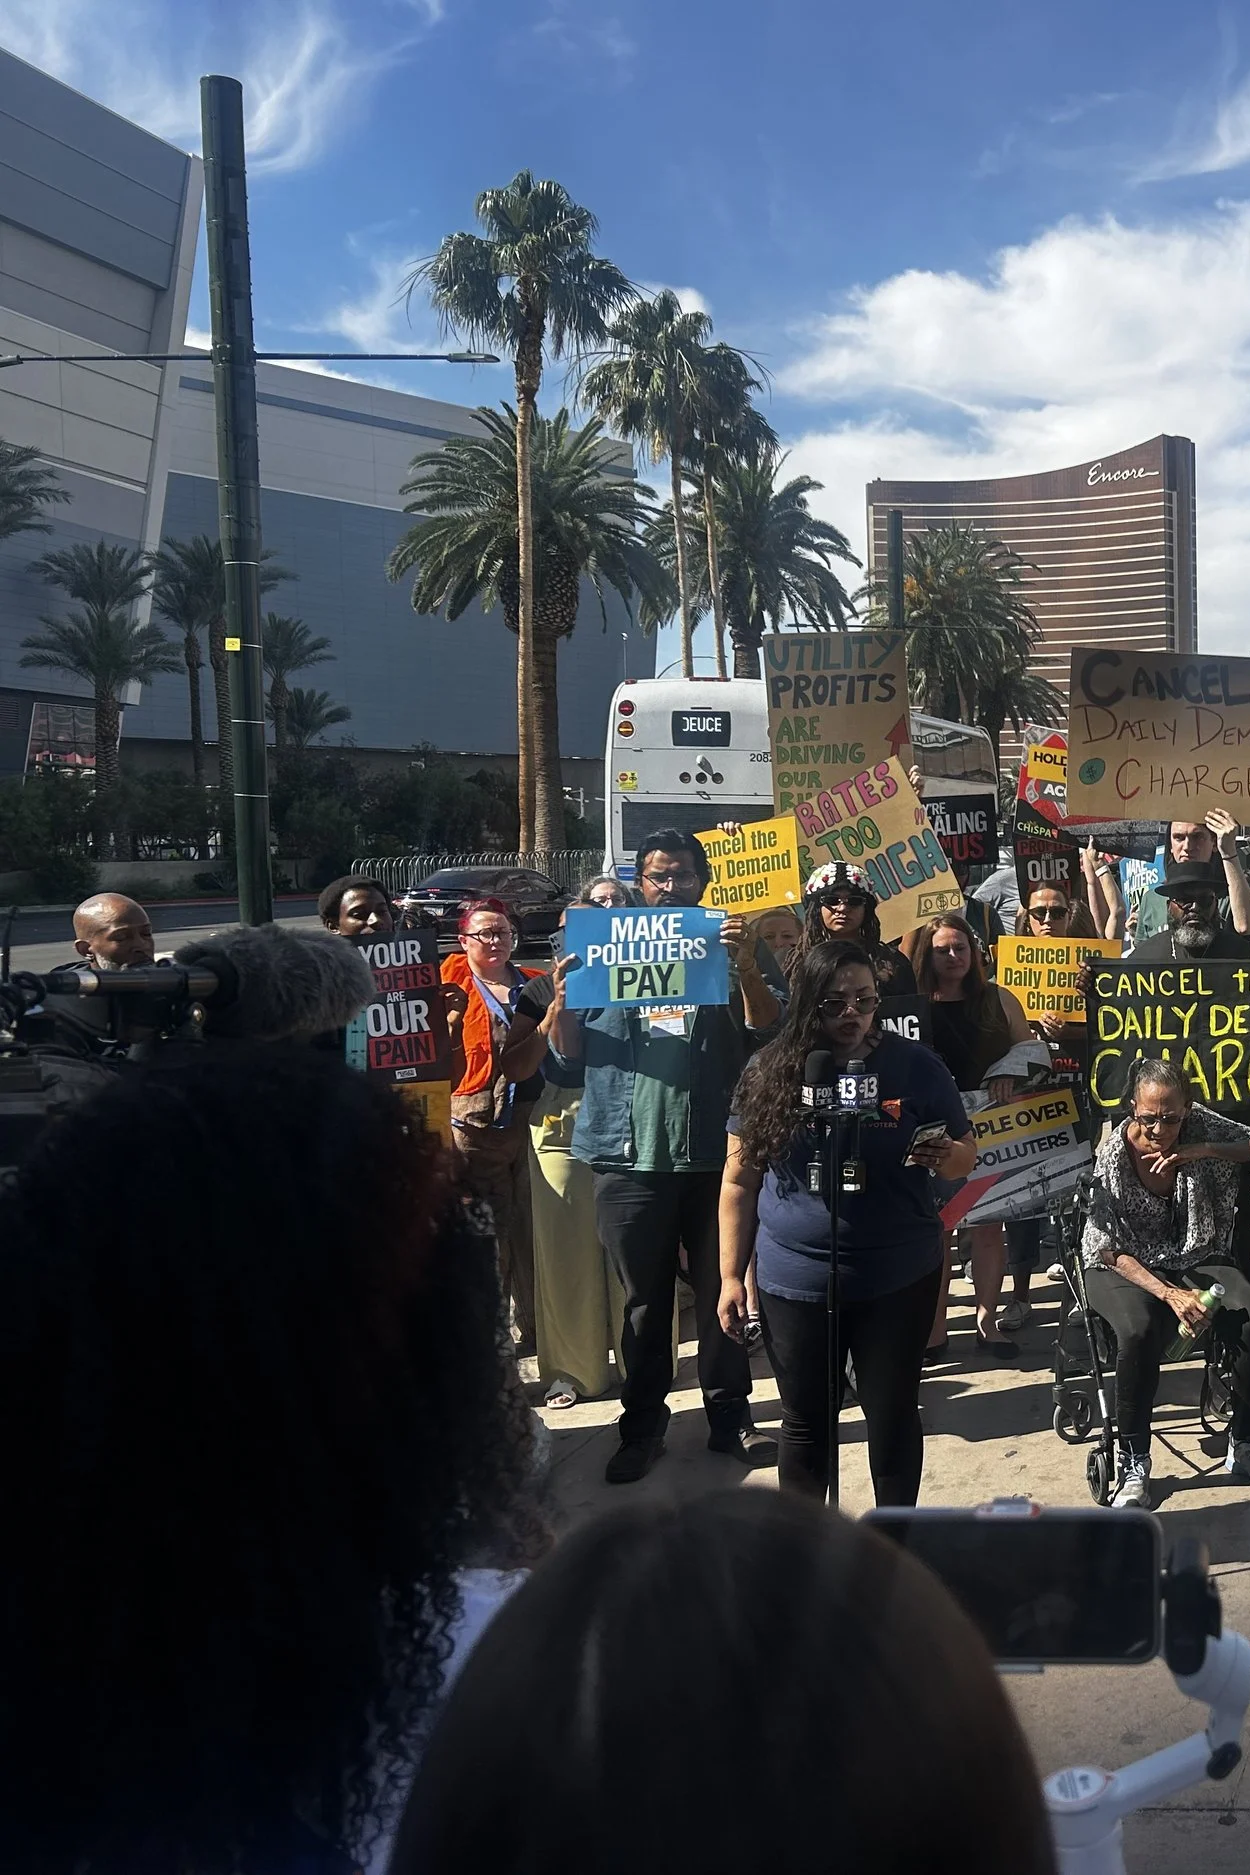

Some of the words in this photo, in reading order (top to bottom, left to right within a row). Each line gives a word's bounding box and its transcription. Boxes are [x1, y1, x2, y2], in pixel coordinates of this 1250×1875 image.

[1087, 463, 1159, 486] Encore
[767, 634, 900, 671] UTILITY
[770, 673, 897, 709] PROFITS
[682, 717, 722, 732] DEUCE
[775, 716, 821, 743] ARE
[1073, 704, 1177, 746] DAILY
[776, 743, 866, 765] DRIVING
[777, 771, 823, 788] OUR
[795, 761, 898, 838] RATES
[703, 833, 746, 859] ancel
[751, 830, 777, 851] the
[816, 816, 881, 861] TOO
[727, 849, 791, 880] Demand
[1027, 858, 1069, 882] OUR
[710, 878, 770, 906] Charge!
[611, 913, 683, 943] MAKE
[358, 940, 422, 968] YOUR
[587, 938, 707, 967] POLLUTERS
[1016, 944, 1070, 965] Cancel
[617, 963, 678, 998] PAY.
[1004, 967, 1042, 989] Daily
[1096, 968, 1213, 998] CANCEL
[386, 991, 406, 1003] ARE
[1027, 991, 1086, 1013] Charge
[366, 999, 431, 1038] OUR
[1097, 1002, 1199, 1040] DAILY
[374, 1033, 433, 1067] PAIN
[816, 1086, 834, 1099] FOX
[1015, 1100, 1072, 1127] OVER
